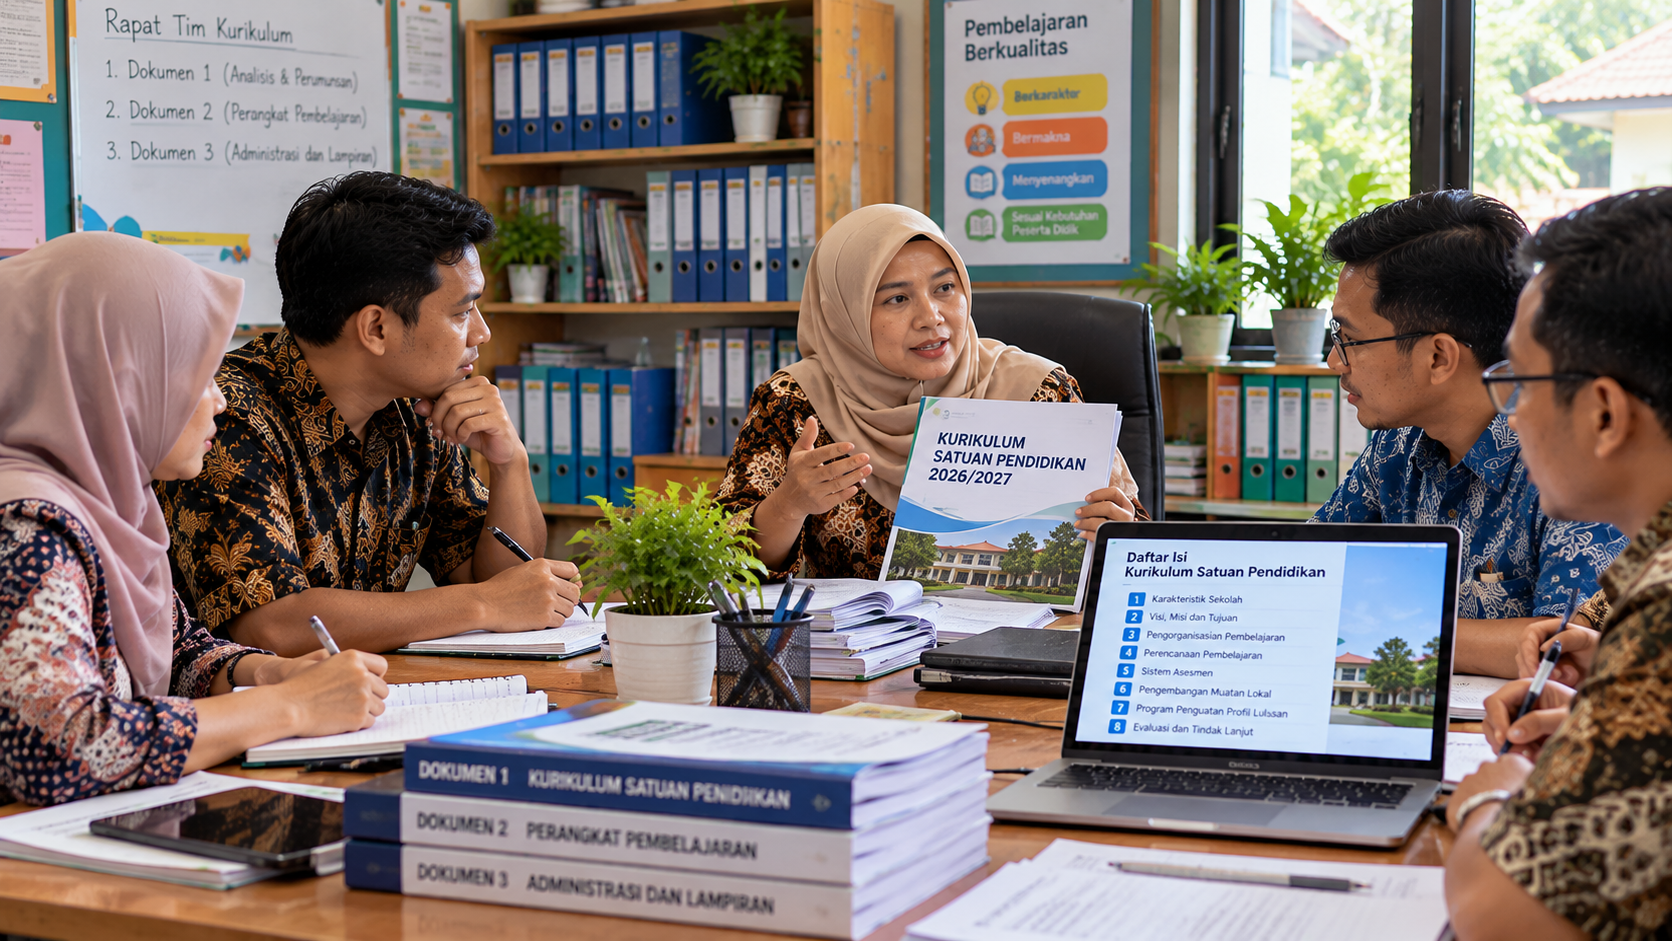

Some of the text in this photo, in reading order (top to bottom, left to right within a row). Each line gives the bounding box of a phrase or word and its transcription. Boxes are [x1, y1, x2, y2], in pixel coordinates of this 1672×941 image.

[105, 7, 293, 44] Rapat Tim Kurikulum
[965, 13, 1088, 38] Pembelajaran
[965, 38, 1068, 62] Berkualitas
[106, 60, 118, 78] 1.
[128, 59, 195, 81] Dokumen
[204, 63, 211, 82] 1
[223, 62, 275, 87] (Analisis
[280, 68, 289, 86] &
[106, 100, 367, 130] 2. Dokumen 2 (Perangkat Pembelajaran)
[1013, 131, 1071, 144] Bermakna
[107, 140, 378, 169] 3. Dokumen 3 (Administrasi dan Lampiran)
[1012, 172, 1094, 188] Menyenangkan
[1012, 209, 1099, 223] Sesuai Kebutuhan
[1012, 223, 1079, 236] Peserta Didik
[937, 432, 1026, 449] KURIKULUM
[933, 450, 1086, 471] SATUAN PENDIDIKAN
[928, 468, 1013, 486] 2026/2027
[1127, 551, 1188, 563] Daftar Isi
[1125, 566, 1326, 578] Kurikulum Satuan Pendidikan
[1134, 595, 1243, 604] 1 Karakteristik Sekolah
[1130, 612, 1238, 624] 2 Visi, Misi dan Tujuan
[1128, 630, 1285, 643] 3 Pengorganisasian Pembelajaran
[1125, 648, 1263, 661] 4 Perencanaan Pembelajaran
[1141, 667, 1171, 676] Sistem
[1173, 668, 1213, 677] Asesmen
[1119, 684, 1272, 698] 6 Pengembangan Muatan Lokal
[1117, 703, 1125, 713] 7
[1136, 704, 1174, 716] Program
[1176, 705, 1224, 717] Penguatan
[1227, 707, 1251, 717] Profil
[1113, 721, 1254, 738] 8 Evaluasi dan Tindak Lanjut
[418, 760, 497, 785] DOKUMEN
[500, 767, 509, 786] 1
[528, 769, 622, 795] KURIKULUM
[624, 776, 690, 801] SATUAN
[417, 811, 758, 860] DOKUMEN 2 PERANGKAT PEMBELAJARAN
[417, 862, 775, 916] DOKUMEN 3 ADMINISTRASI DAN LAMPIRAN
